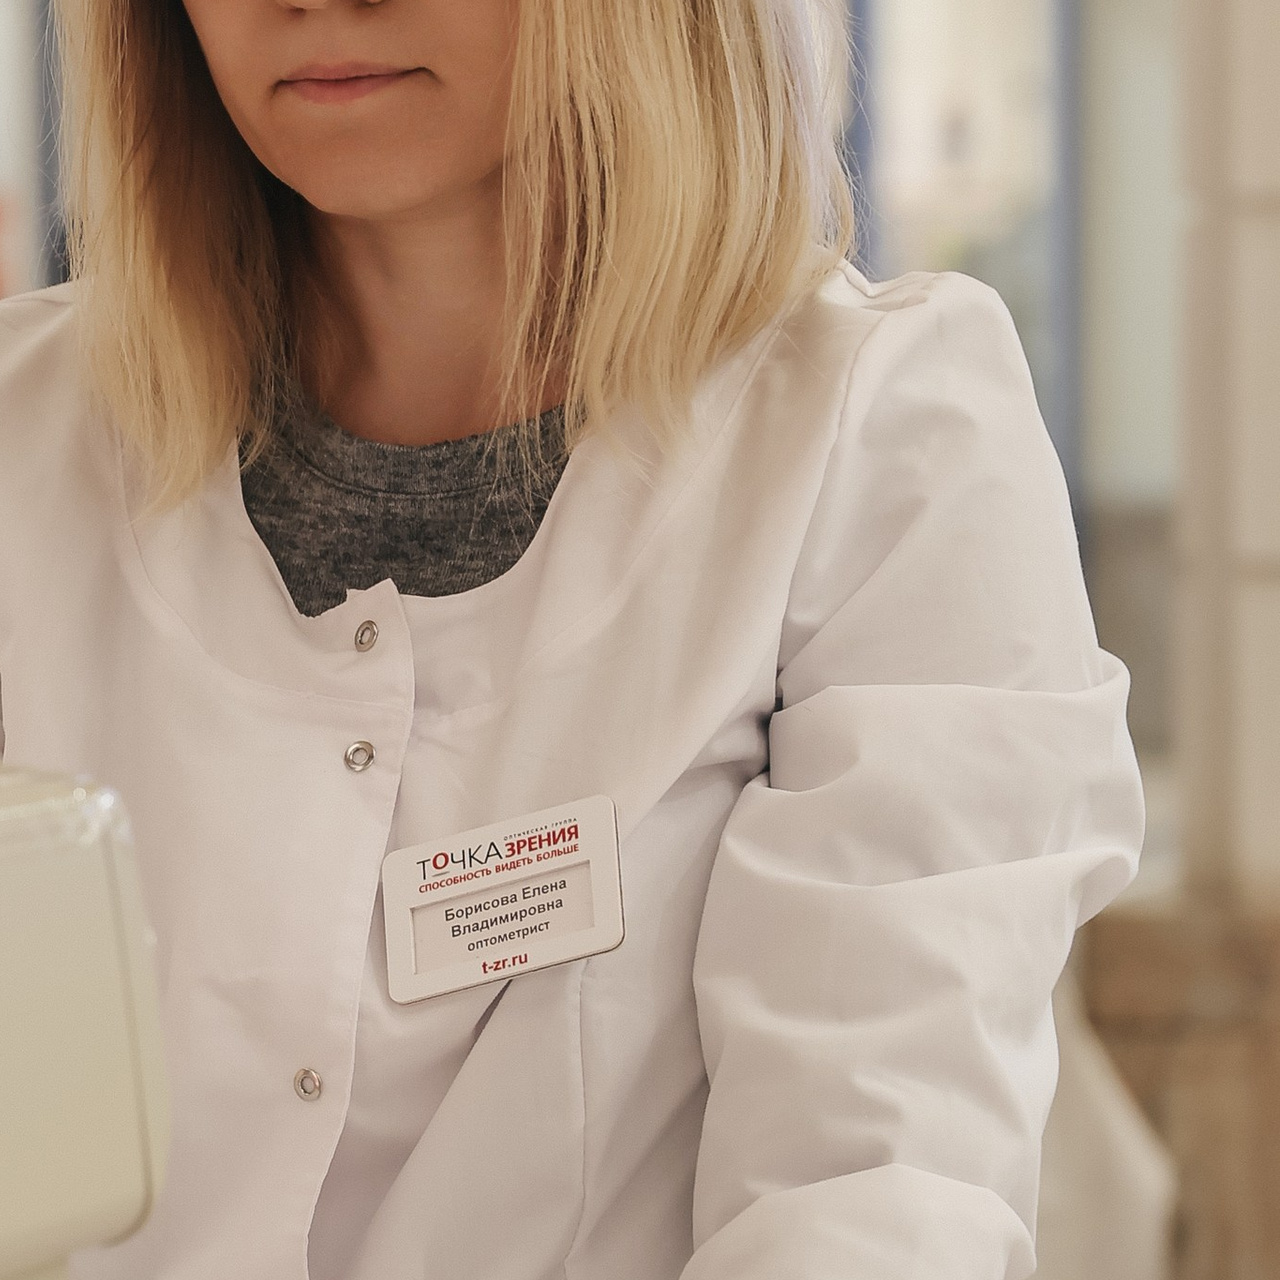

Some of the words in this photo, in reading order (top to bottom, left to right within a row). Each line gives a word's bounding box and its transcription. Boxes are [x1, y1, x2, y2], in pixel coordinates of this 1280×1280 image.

[416, 841, 503, 880] ТОЧКА
[505, 824, 579, 858] ЗРЕНИЯ
[418, 867, 492, 894] СПОСОБНОСТЬ
[495, 857, 533, 874] ВИДЕТЬ
[536, 843, 580, 862] БОЛЬШЕ
[444, 893, 518, 921] Борисова
[521, 879, 567, 900] Елена
[451, 898, 564, 938] Владимировна
[467, 921, 551, 952] оптометрист
[481, 953, 529, 974] t-zr.ru
